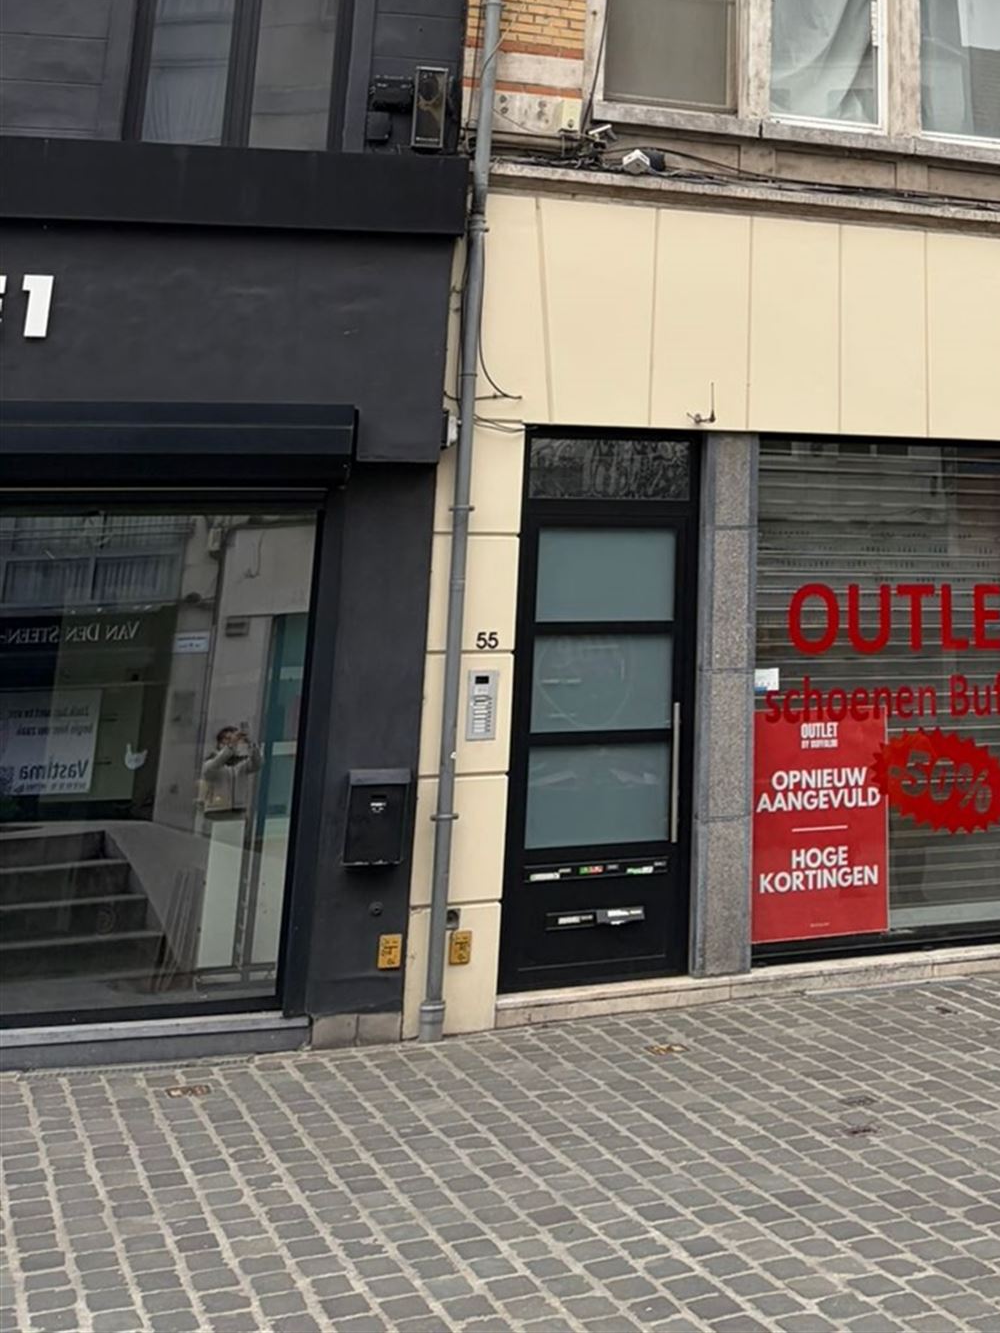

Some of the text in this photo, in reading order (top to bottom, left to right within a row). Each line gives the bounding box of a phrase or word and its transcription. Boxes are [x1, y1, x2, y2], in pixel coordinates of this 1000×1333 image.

[476, 632, 499, 649] 55
[765, 676, 936, 724] schoenen
[801, 722, 839, 739] OUTLET
[771, 767, 867, 791] OPNIEUW
[757, 788, 881, 813] AANGEVULD
[791, 845, 848, 868] HOGE
[758, 865, 879, 894] KORTINGEN
